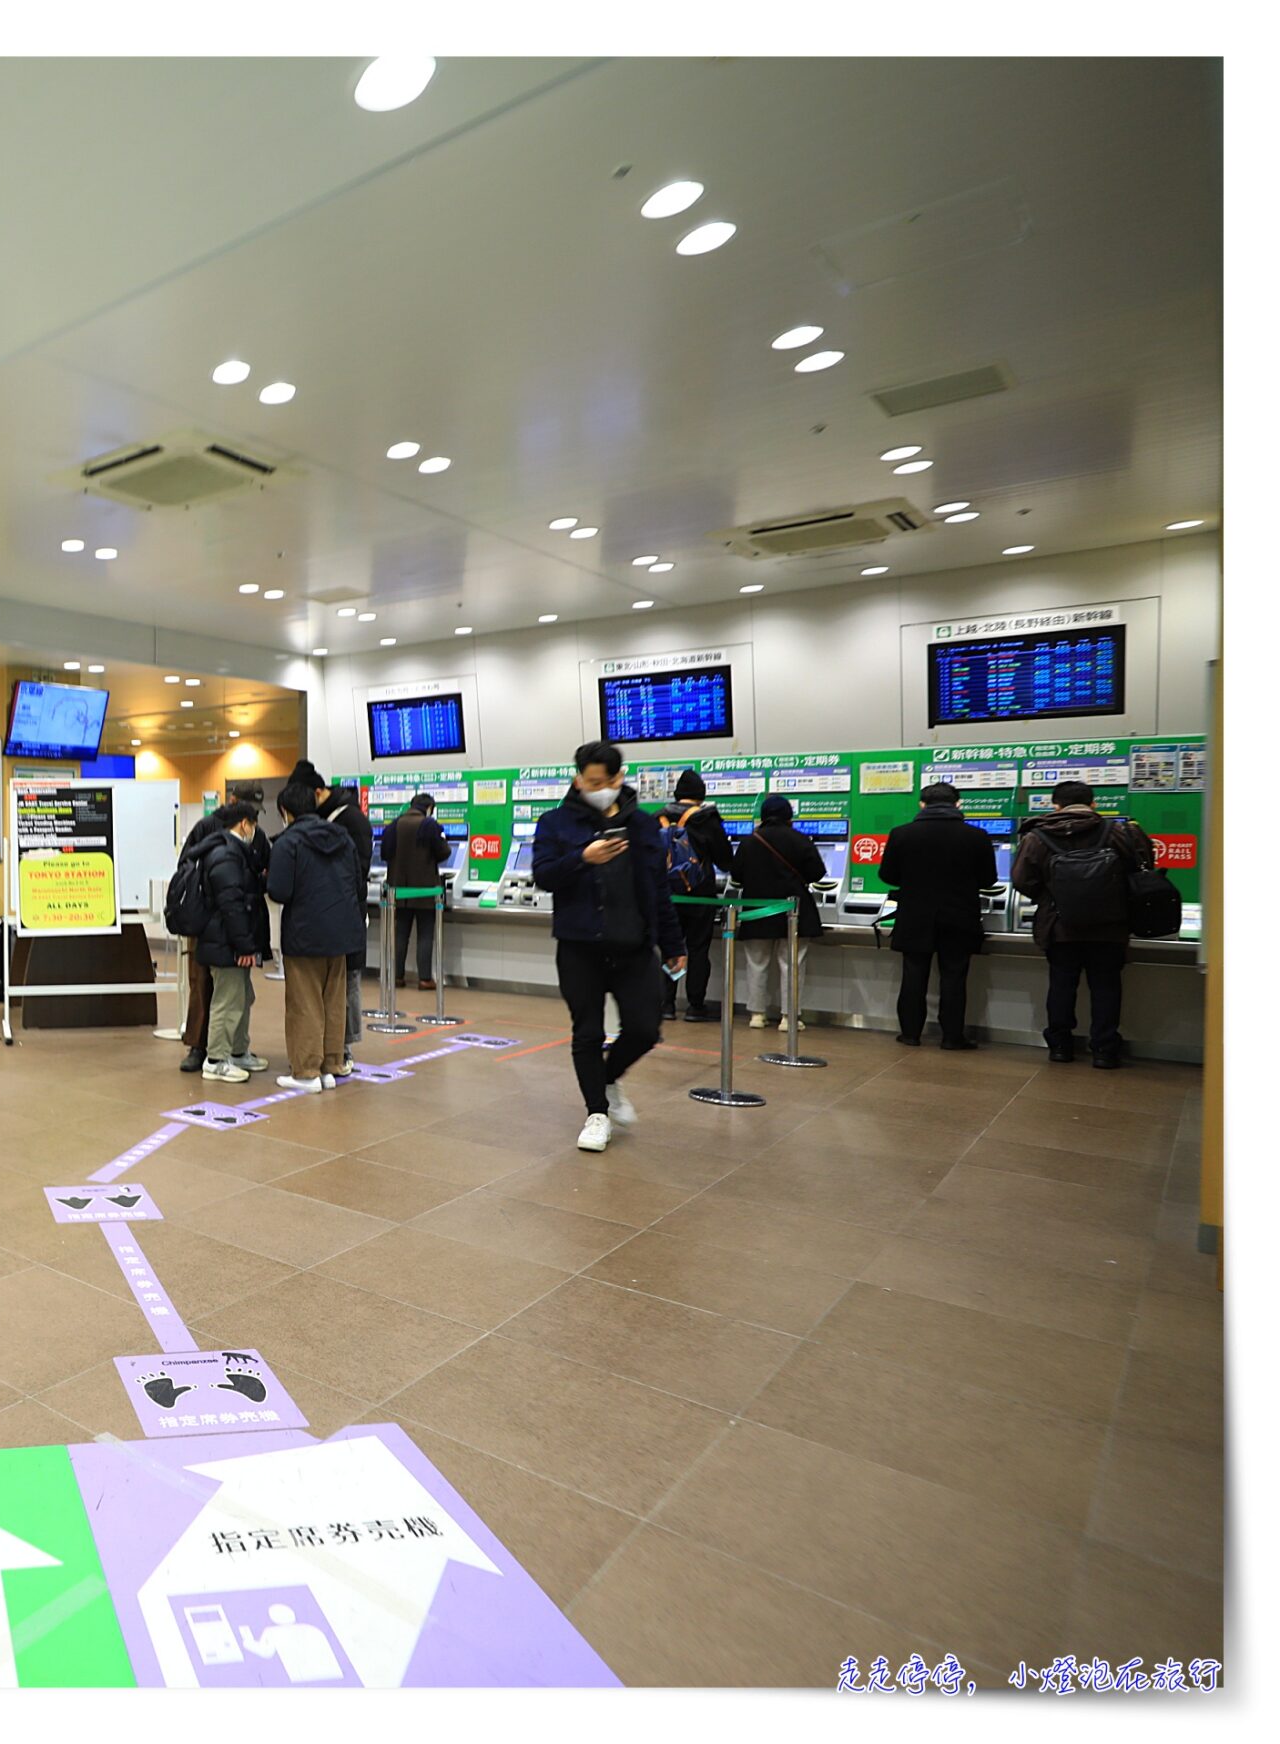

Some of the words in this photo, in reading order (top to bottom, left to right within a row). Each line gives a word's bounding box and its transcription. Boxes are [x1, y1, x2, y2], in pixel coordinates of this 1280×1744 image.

[29, 871, 61, 879] TOKYO
[64, 870, 105, 879] STATION
[161, 1359, 219, 1368] Chimpanzee
[158, 1410, 281, 1429] 指定席券売機
[209, 1516, 443, 1554] 指定席券売機
